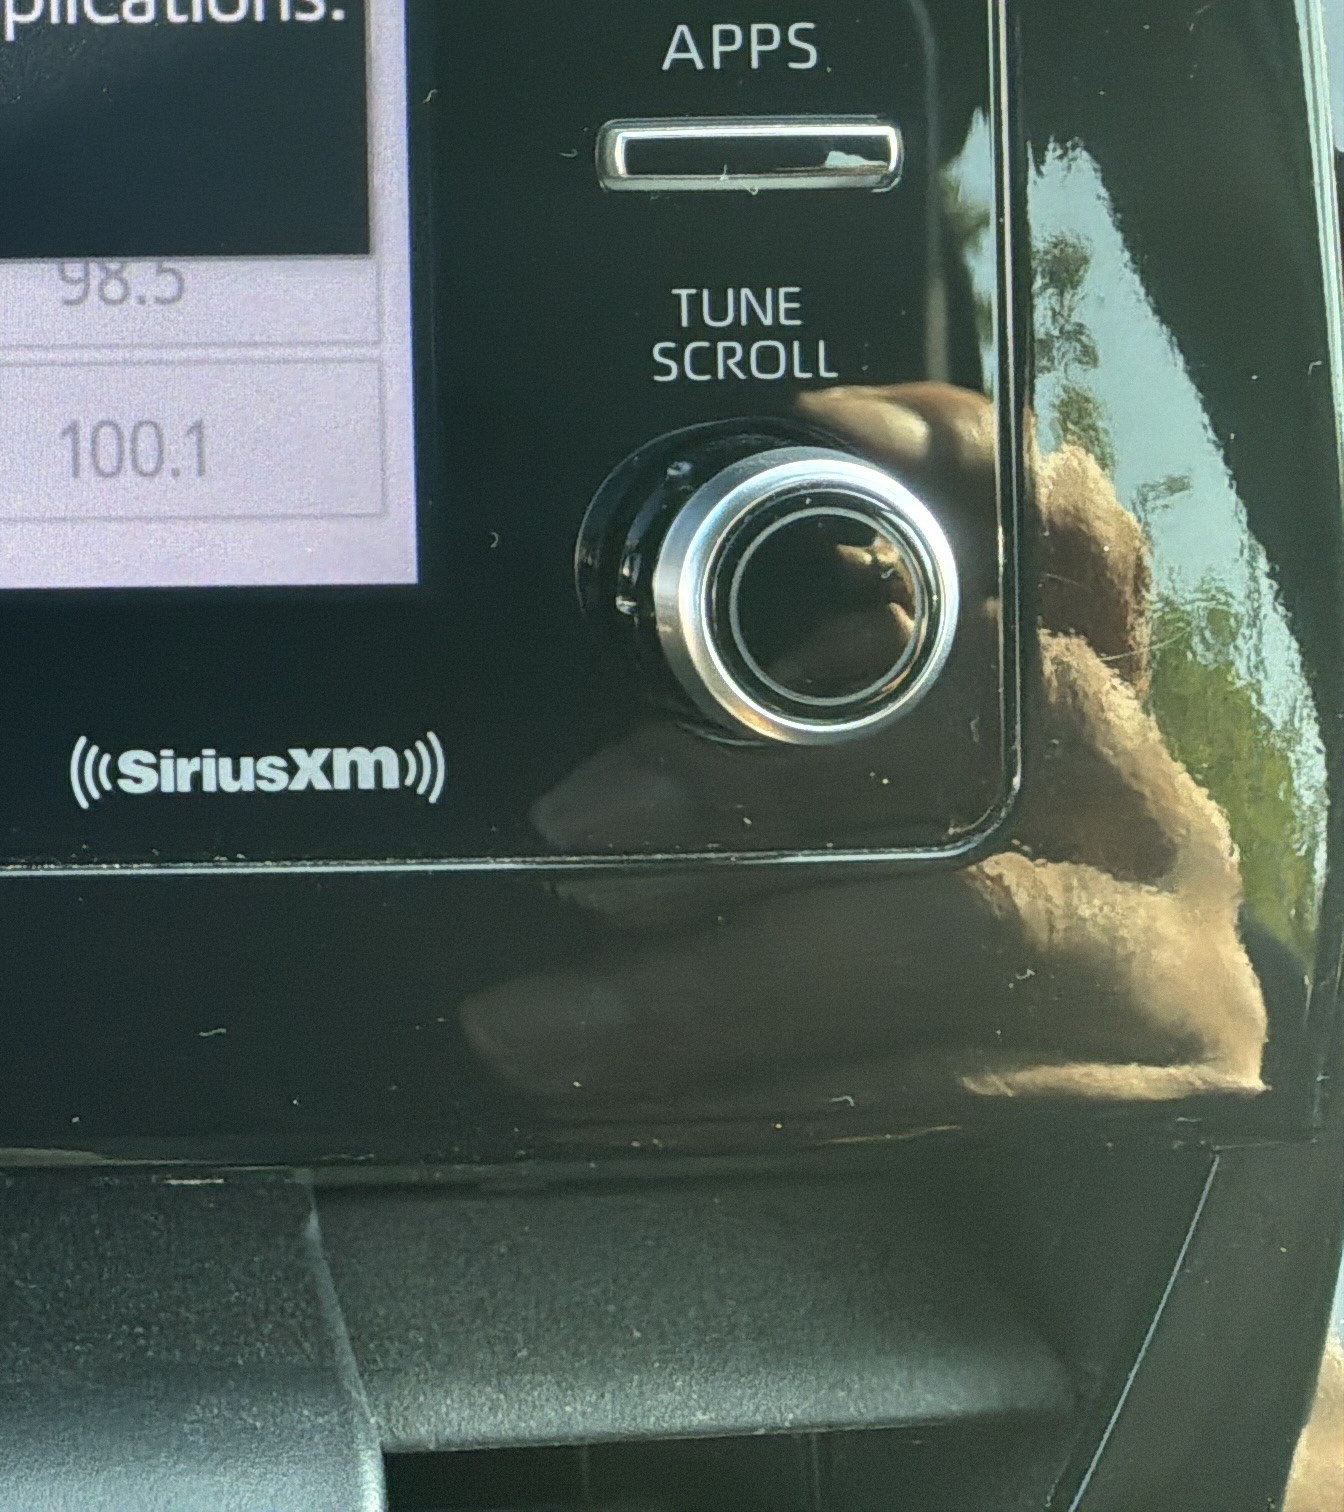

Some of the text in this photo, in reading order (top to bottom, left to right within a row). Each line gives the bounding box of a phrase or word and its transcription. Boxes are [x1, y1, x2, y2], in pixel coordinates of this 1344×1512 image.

[662, 21, 819, 70] APPS
[672, 286, 803, 328] TUNE
[652, 340, 840, 384] SCROLL
[59, 418, 209, 480] 100.1
